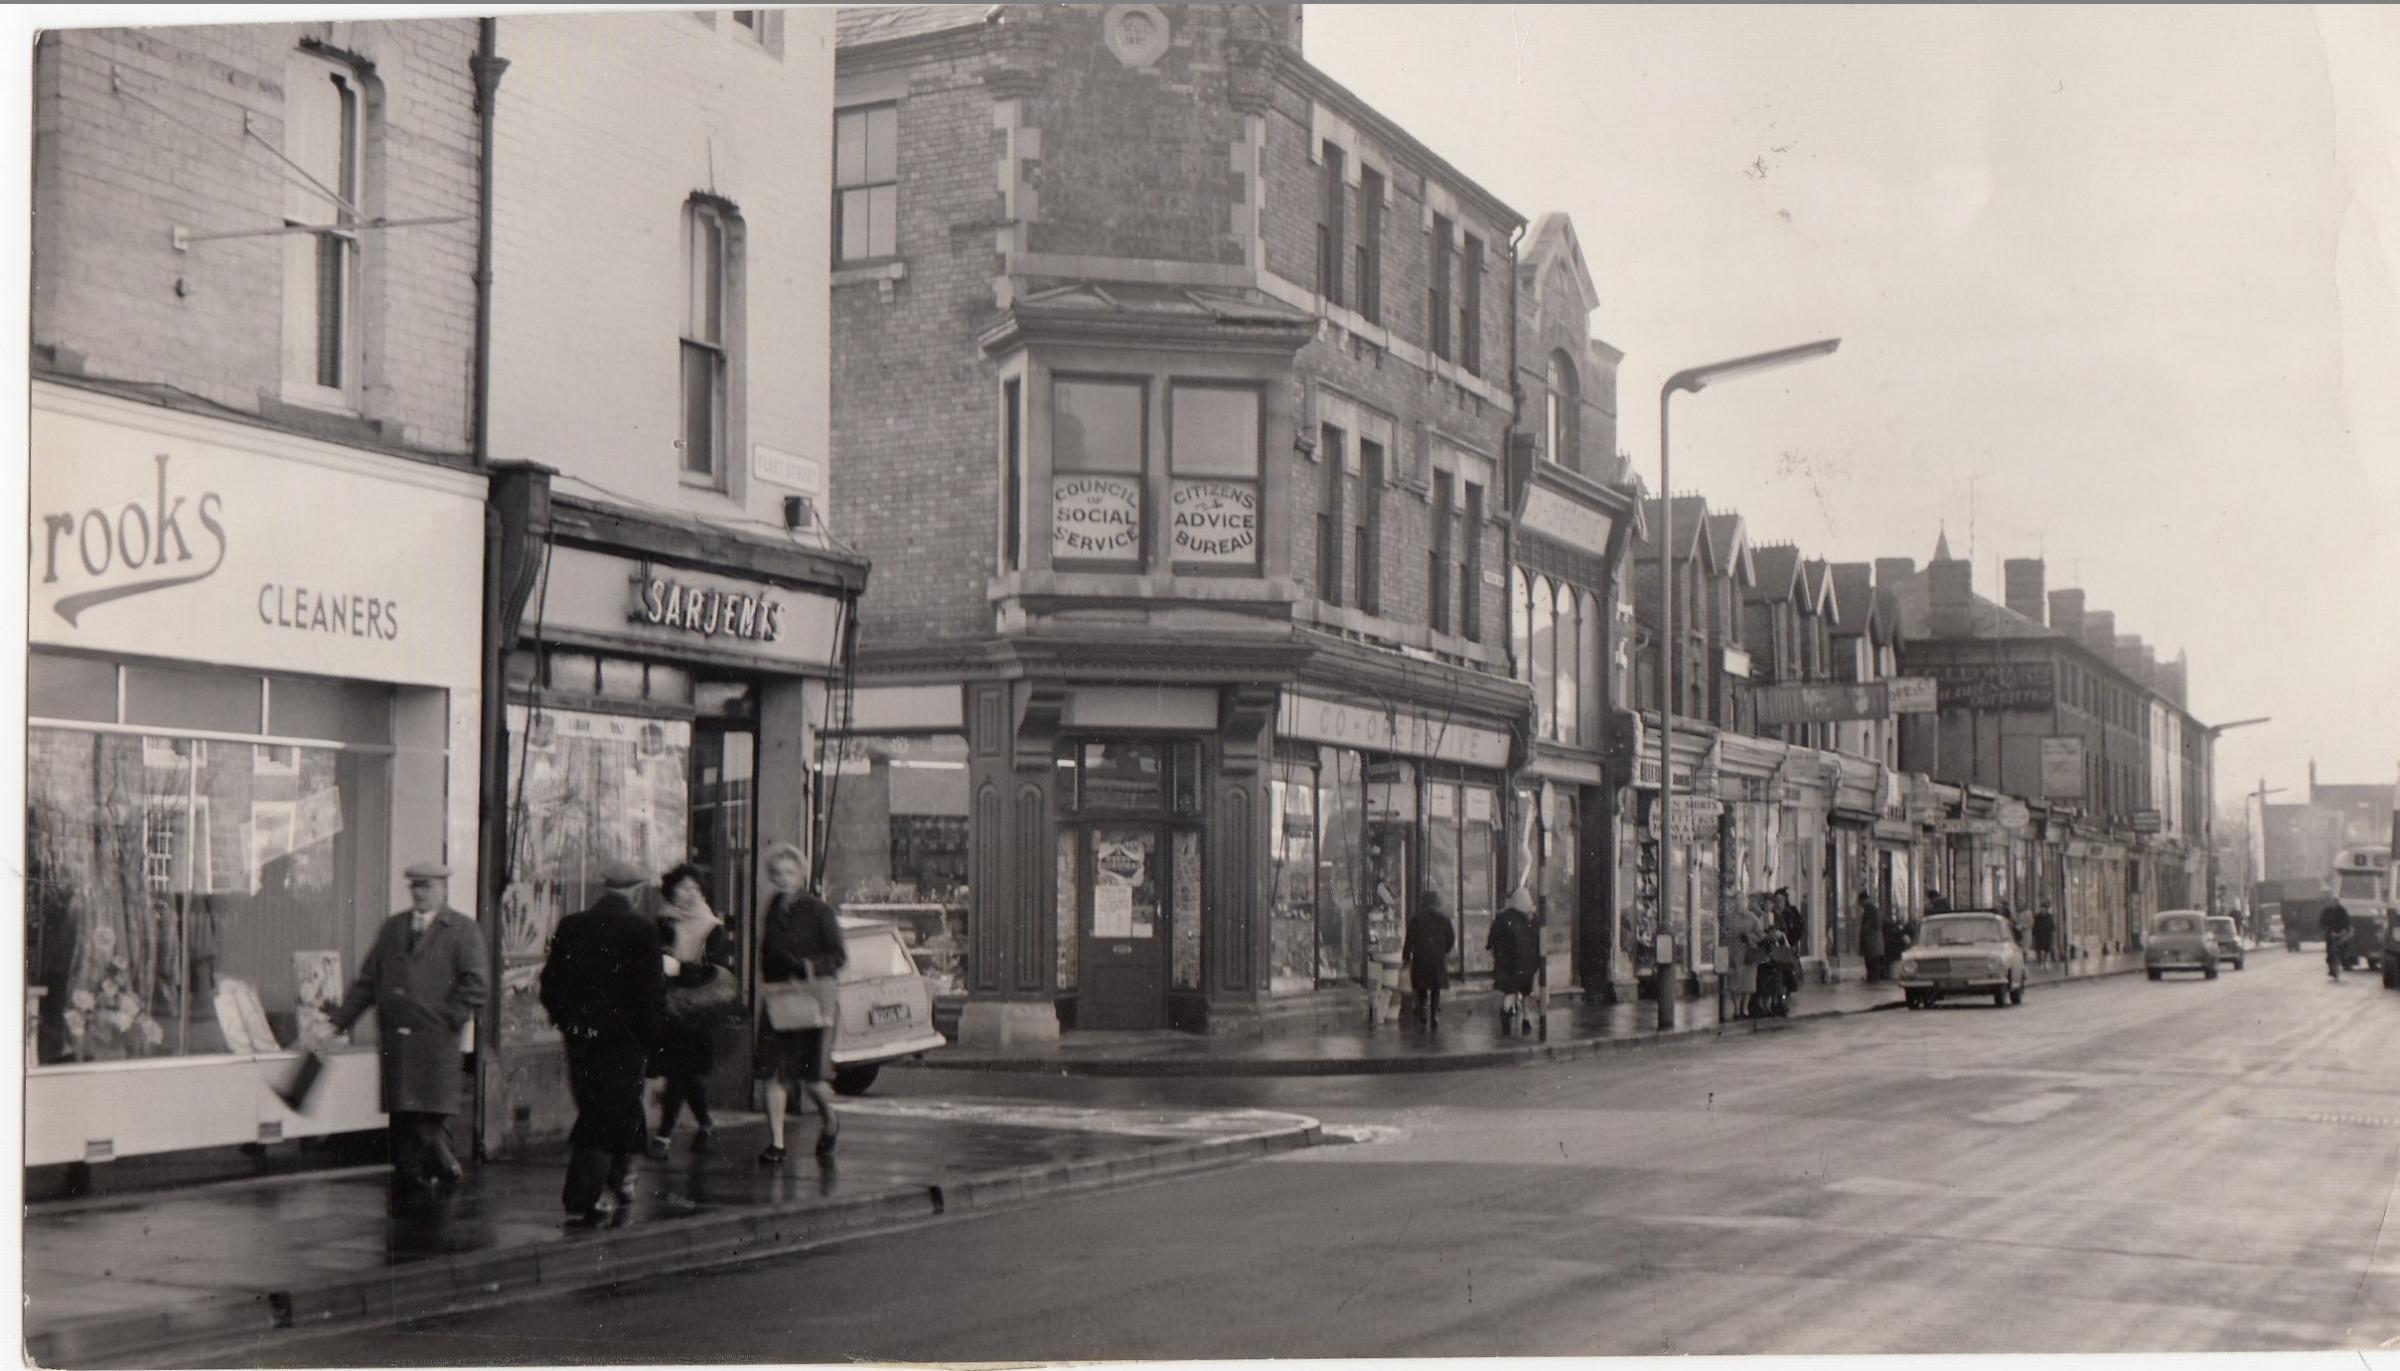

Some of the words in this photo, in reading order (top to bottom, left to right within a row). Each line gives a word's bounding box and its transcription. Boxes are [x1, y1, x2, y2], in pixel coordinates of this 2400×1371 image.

[1055, 479, 1137, 508] COUNCIL
[1173, 484, 1255, 510] CITIZENS
[29, 455, 226, 605] rooks
[1057, 508, 1138, 525] SOCIAL
[1174, 513, 1255, 528] ADVICE
[1053, 526, 1138, 551] SERVICE
[1175, 530, 1254, 555] BUREAU
[258, 583, 398, 641] CLEANERS
[648, 580, 787, 642] SARJENTS
[1320, 705, 1479, 759] CO-OERIVE
